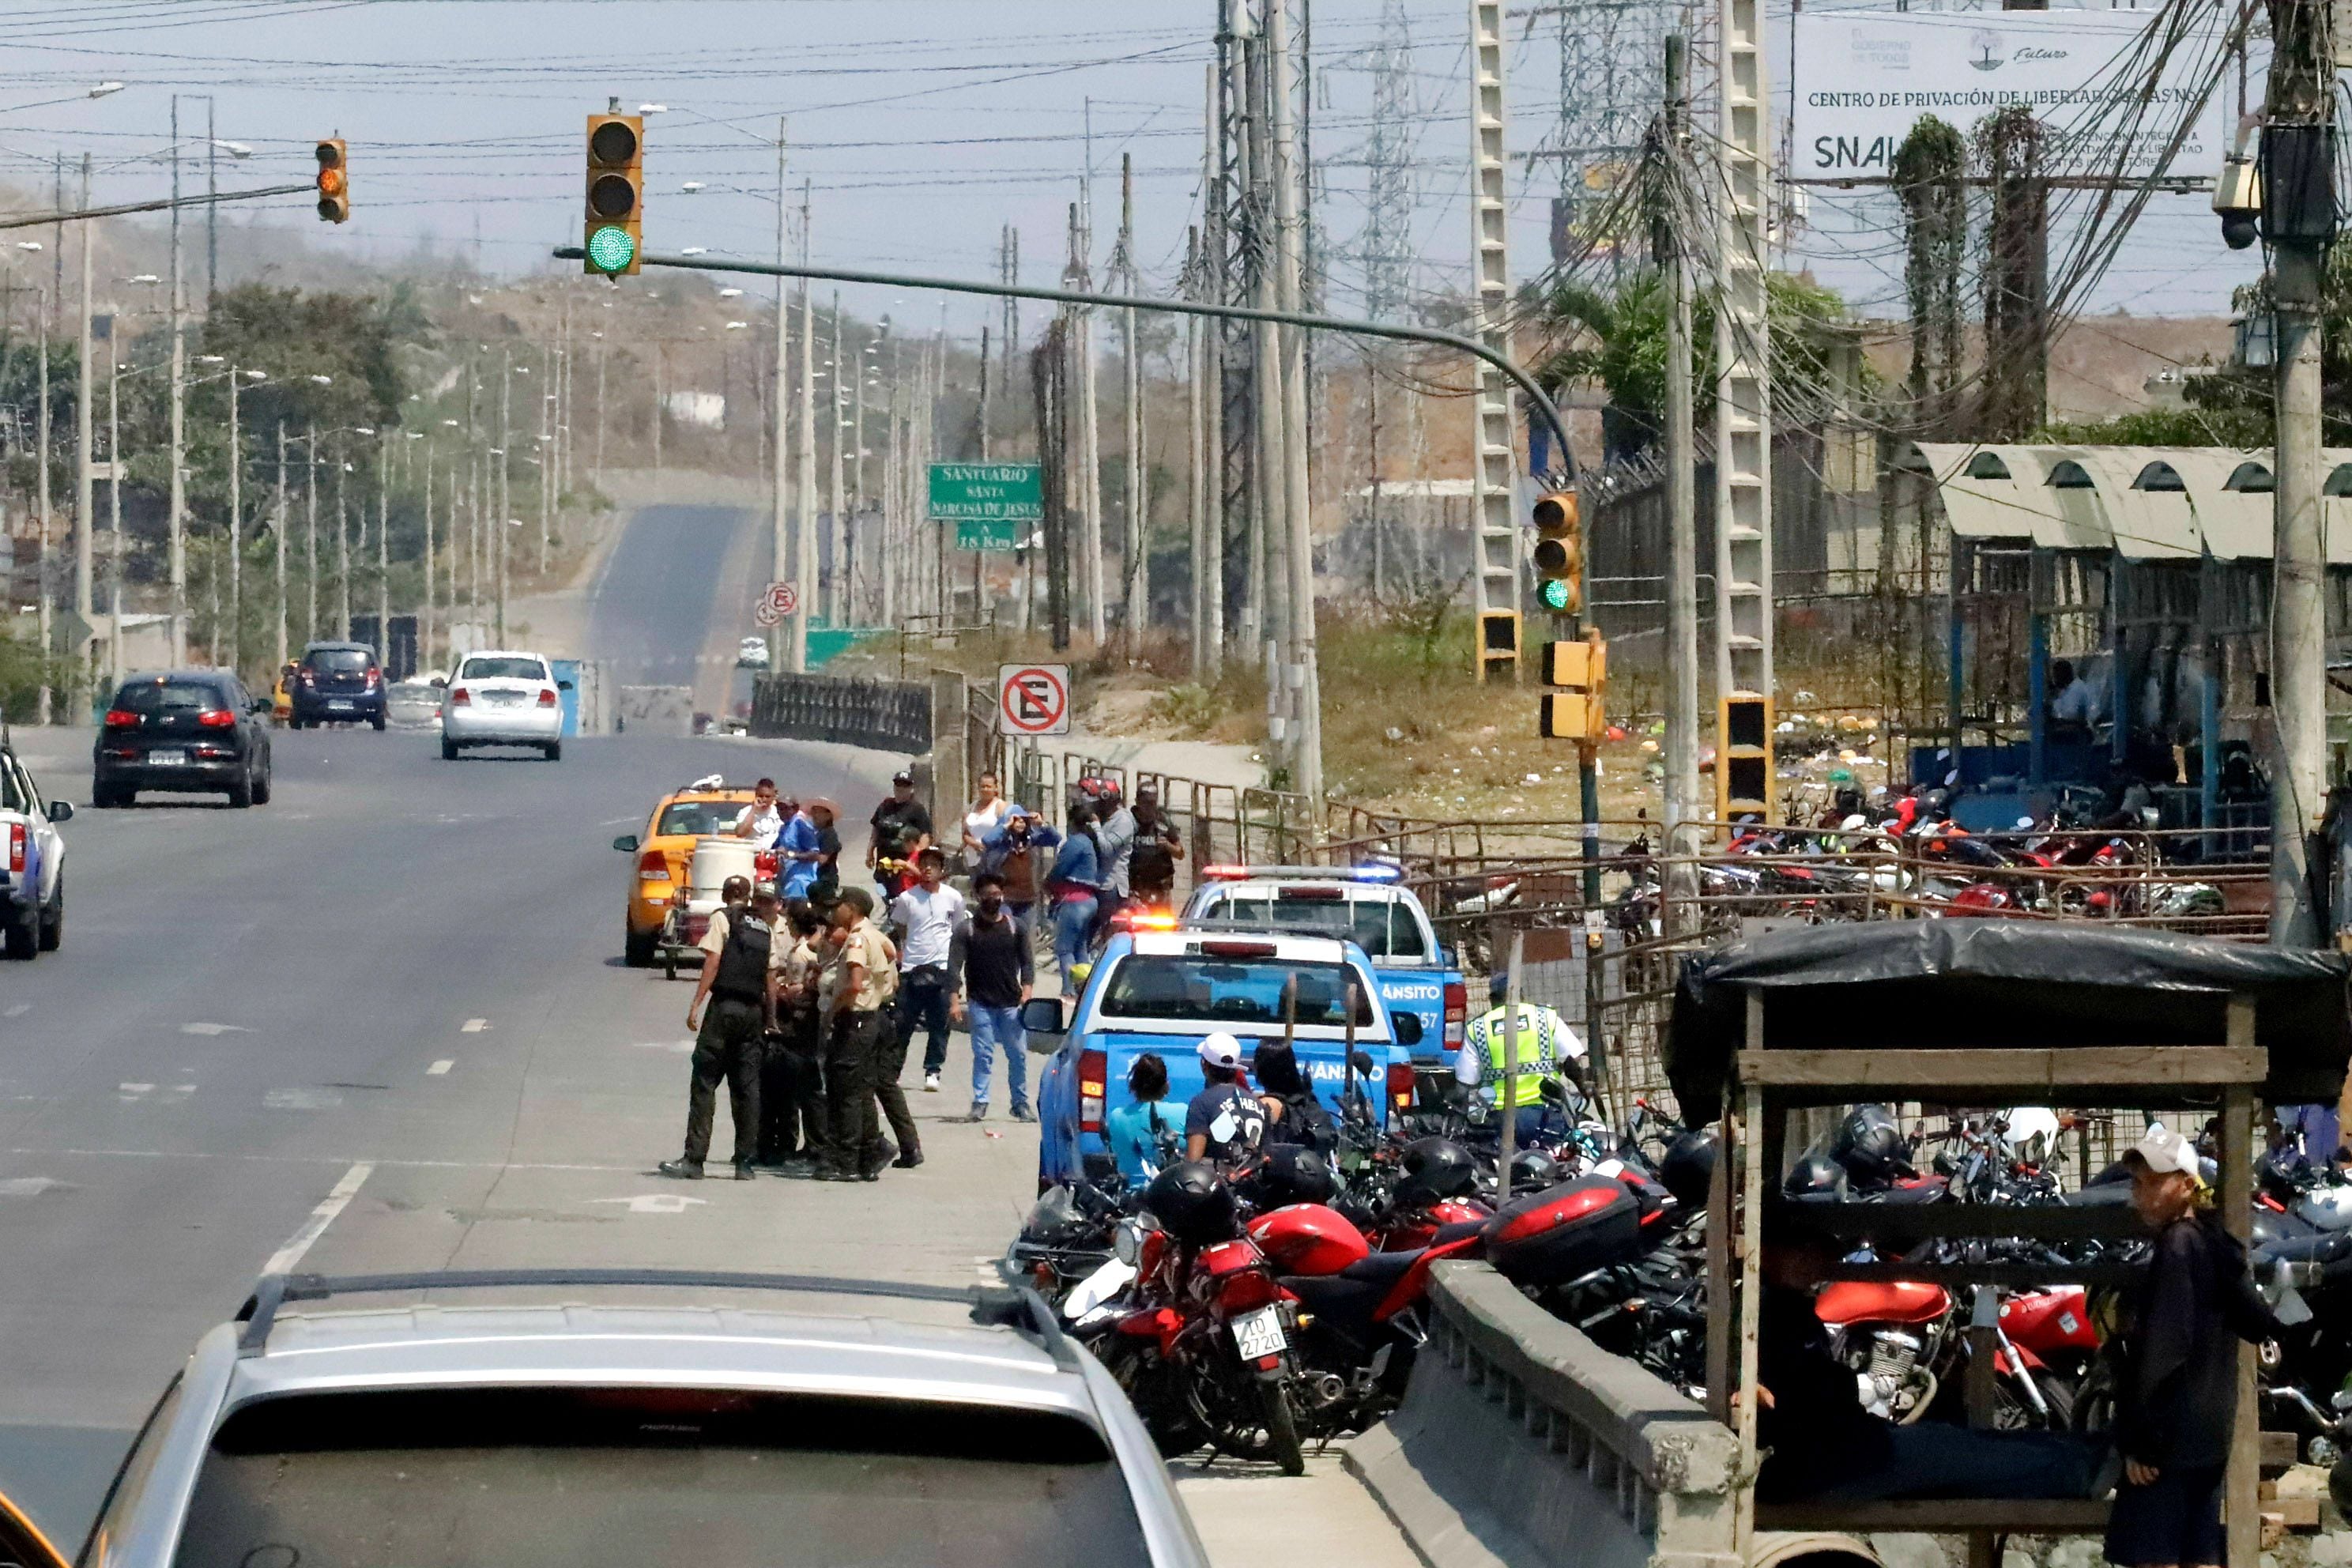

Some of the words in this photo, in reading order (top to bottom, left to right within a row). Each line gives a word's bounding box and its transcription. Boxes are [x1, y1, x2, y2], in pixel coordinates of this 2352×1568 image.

[1808, 92, 1875, 107] CENTRO
[1879, 92, 1901, 107] DE
[1905, 89, 1994, 107] PRIVACIÓN
[1999, 89, 2020, 105] DE
[2023, 89, 2104, 104] LIBERTAD
[2149, 145, 2203, 153] LIBTAD
[1020, 681, 1048, 719] E
[1416, 1012, 1438, 1029] 57
